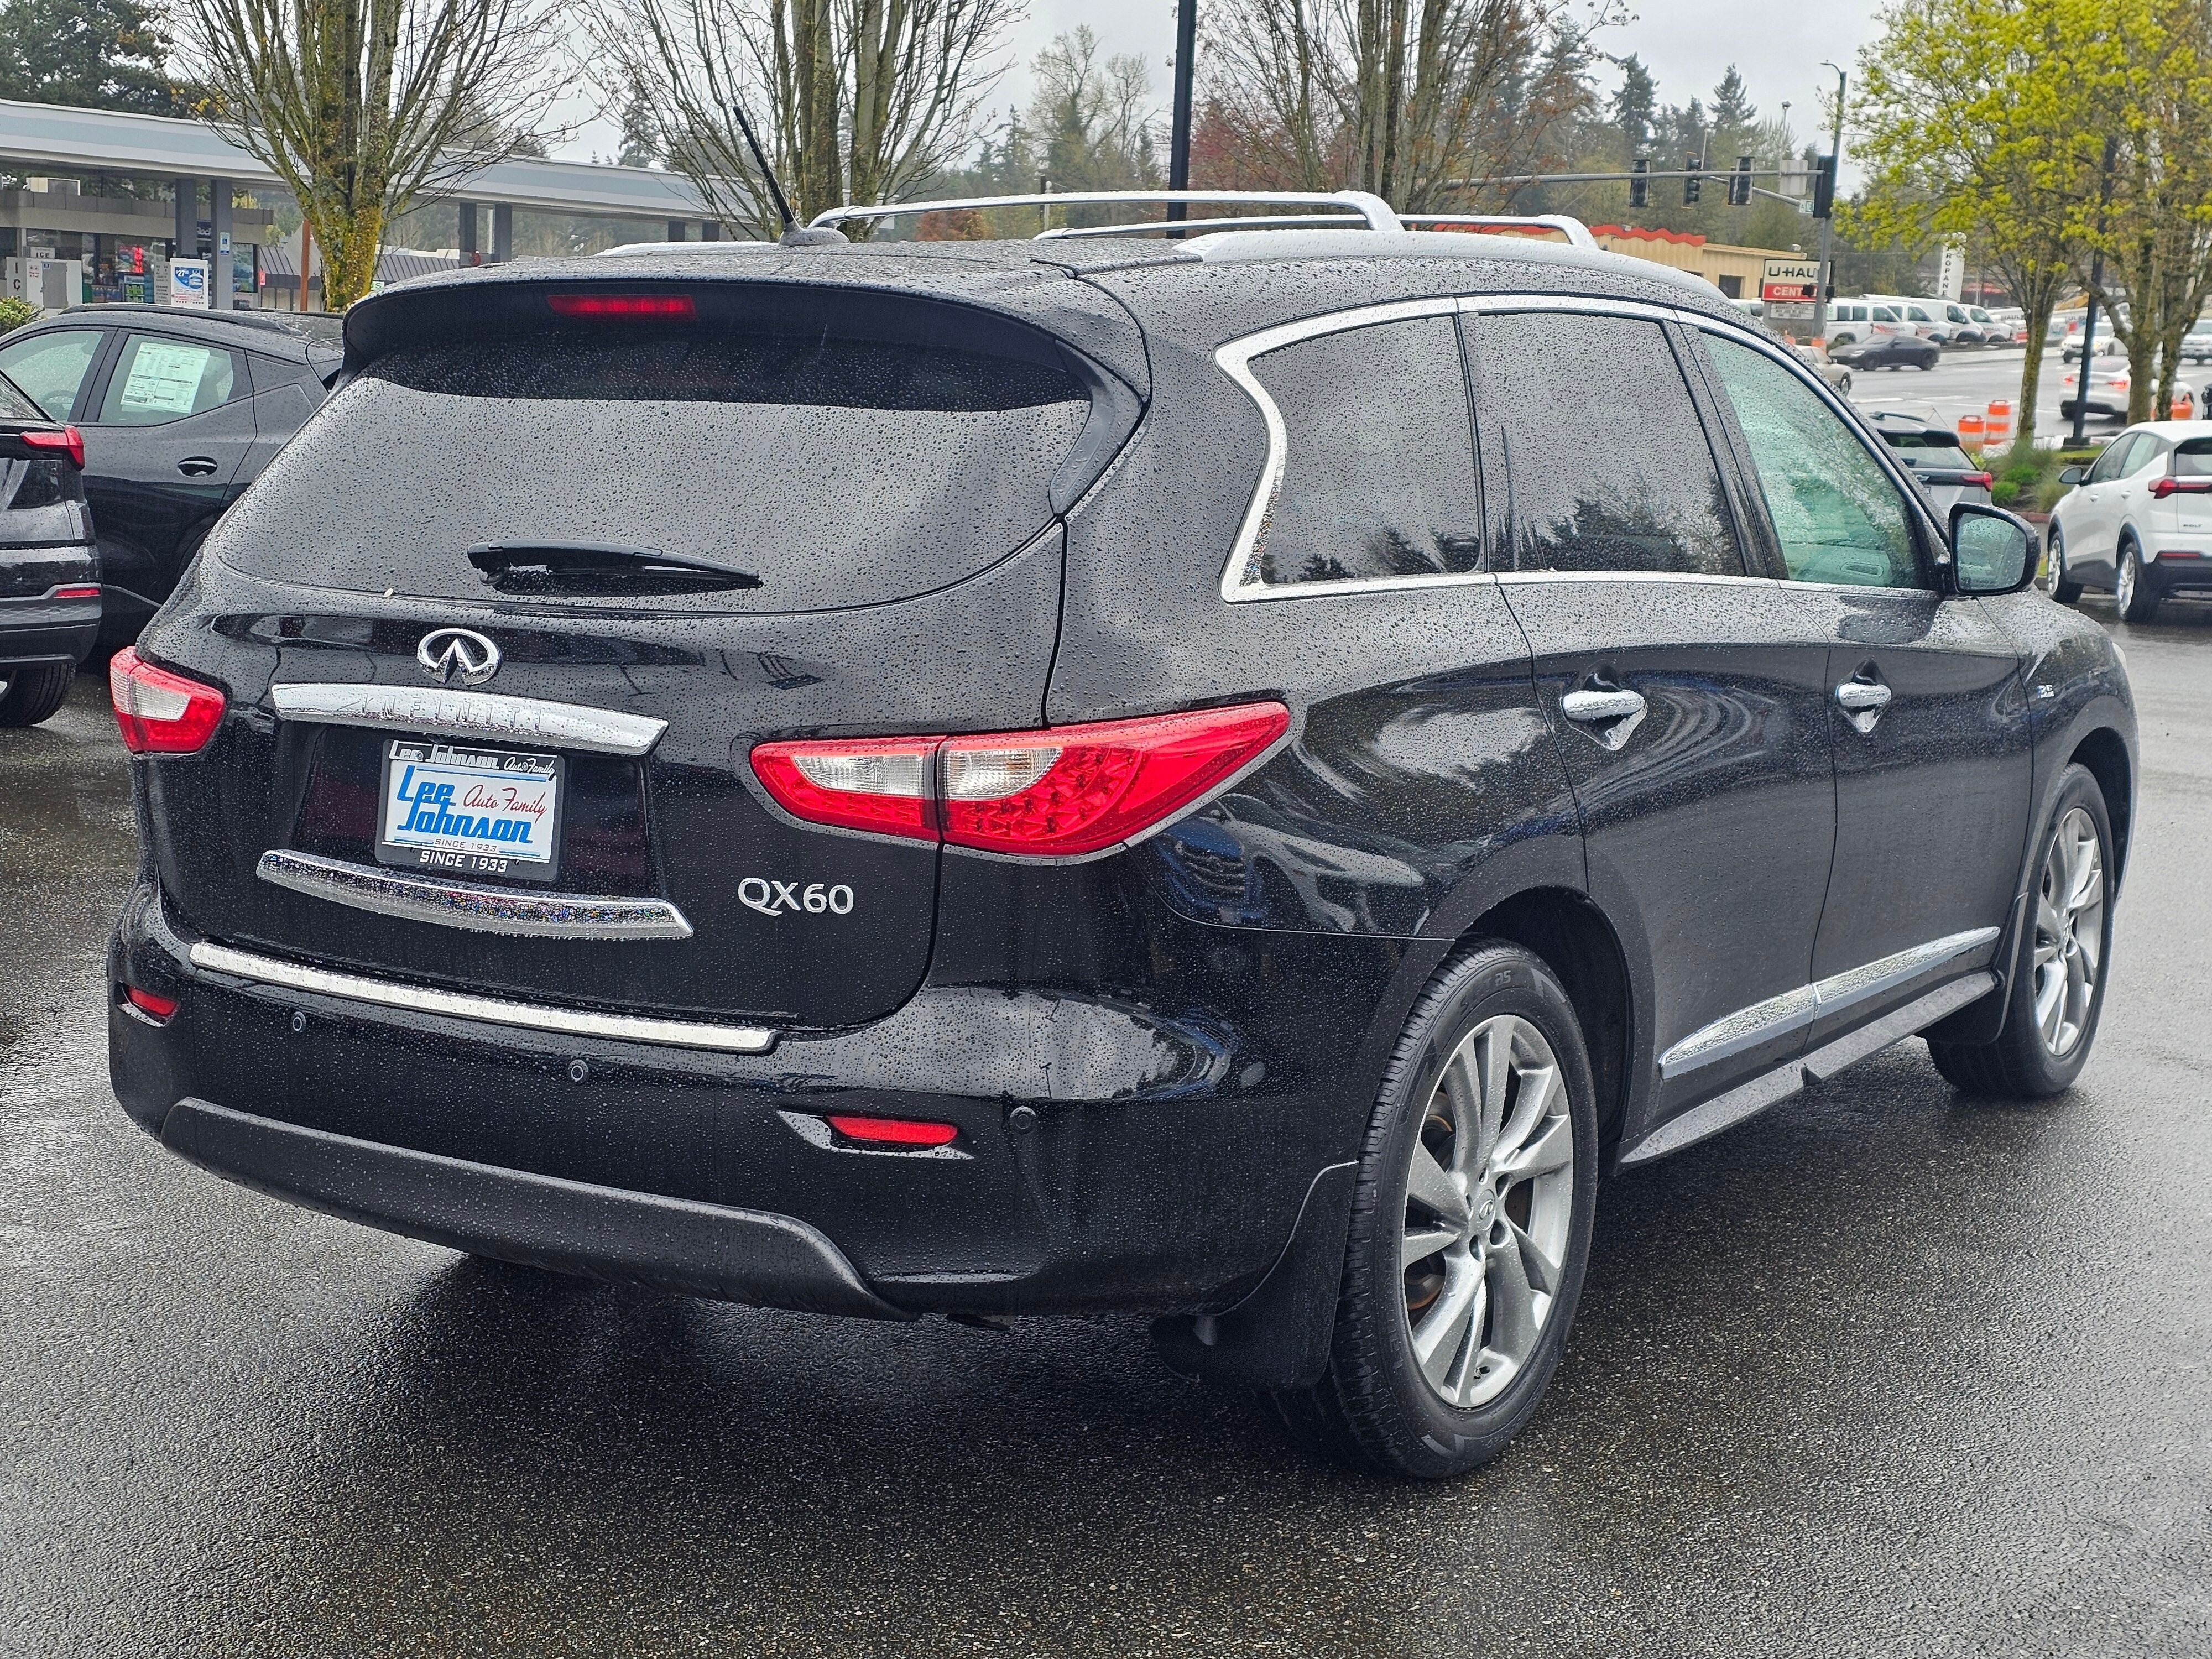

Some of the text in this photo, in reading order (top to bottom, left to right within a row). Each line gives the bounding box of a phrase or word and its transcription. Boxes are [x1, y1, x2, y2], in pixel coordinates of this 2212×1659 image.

[1768, 267, 1817, 278] U-HAU
[1773, 286, 1818, 297] CENT
[360, 692, 544, 731] INFINITI
[425, 744, 499, 769] Johnson
[526, 758, 555, 781] Family
[397, 765, 547, 824] Lee Auto Family
[397, 801, 533, 844] Johnson
[419, 850, 508, 873] SINCE 1933
[434, 838, 497, 852] SINCE 1933
[738, 877, 854, 916] QX60
